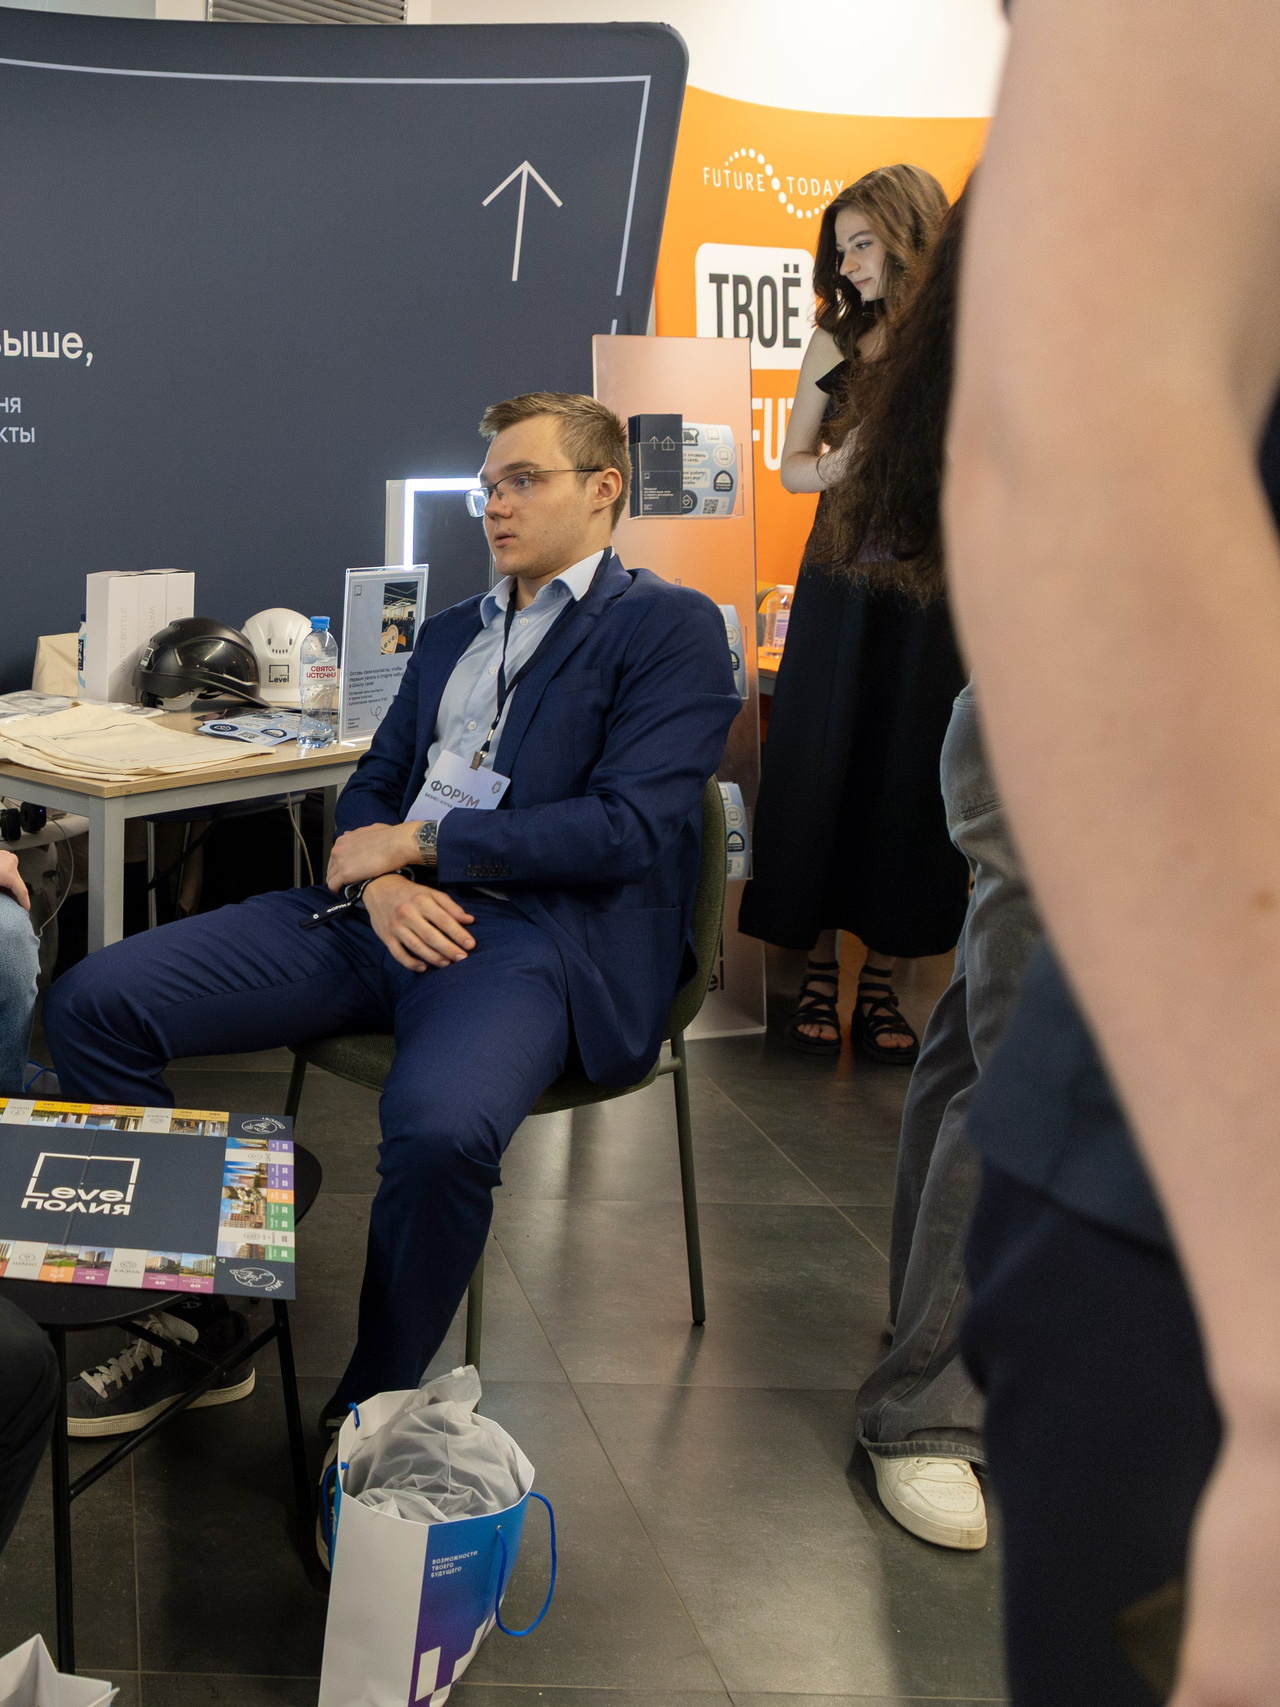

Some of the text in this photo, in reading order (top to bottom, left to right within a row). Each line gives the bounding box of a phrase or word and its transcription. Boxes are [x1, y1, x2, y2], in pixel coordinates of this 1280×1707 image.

[703, 167, 844, 197] FUTURE TODAY
[708, 263, 802, 348] ТВОЁ
[430, 780, 480, 809] ФОРУМ
[431, 1562, 455, 1571] ТВОЕГО
[432, 1551, 478, 1565] ВОЗМОЖНОСТИ
[431, 1566, 462, 1578] БУДУЩЕГО
